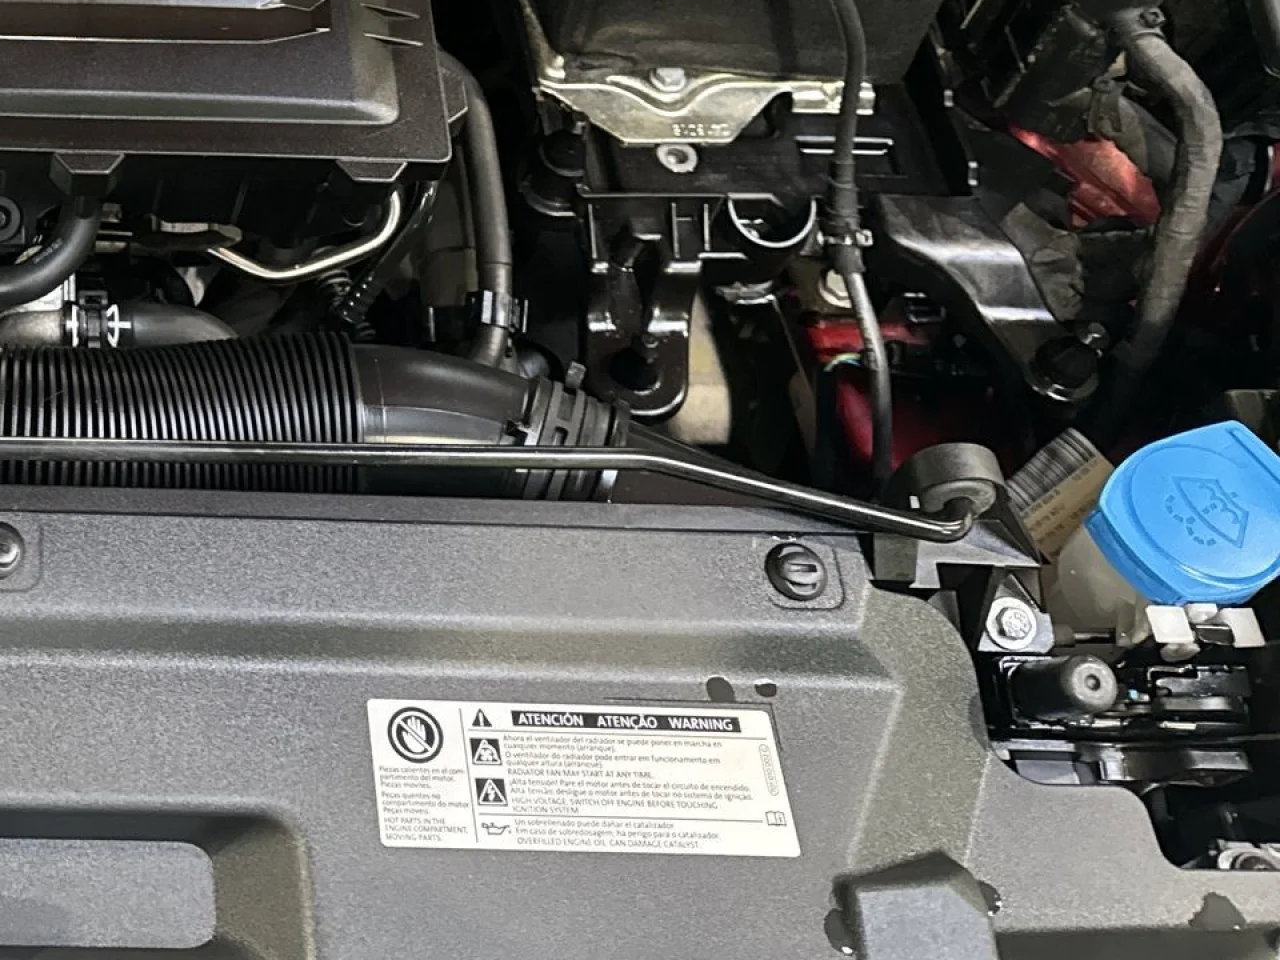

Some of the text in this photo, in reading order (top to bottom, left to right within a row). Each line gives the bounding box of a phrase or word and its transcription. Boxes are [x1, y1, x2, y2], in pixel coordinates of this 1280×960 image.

[518, 712, 733, 730] ATENCIÓN ATENÇÃO WARNING
